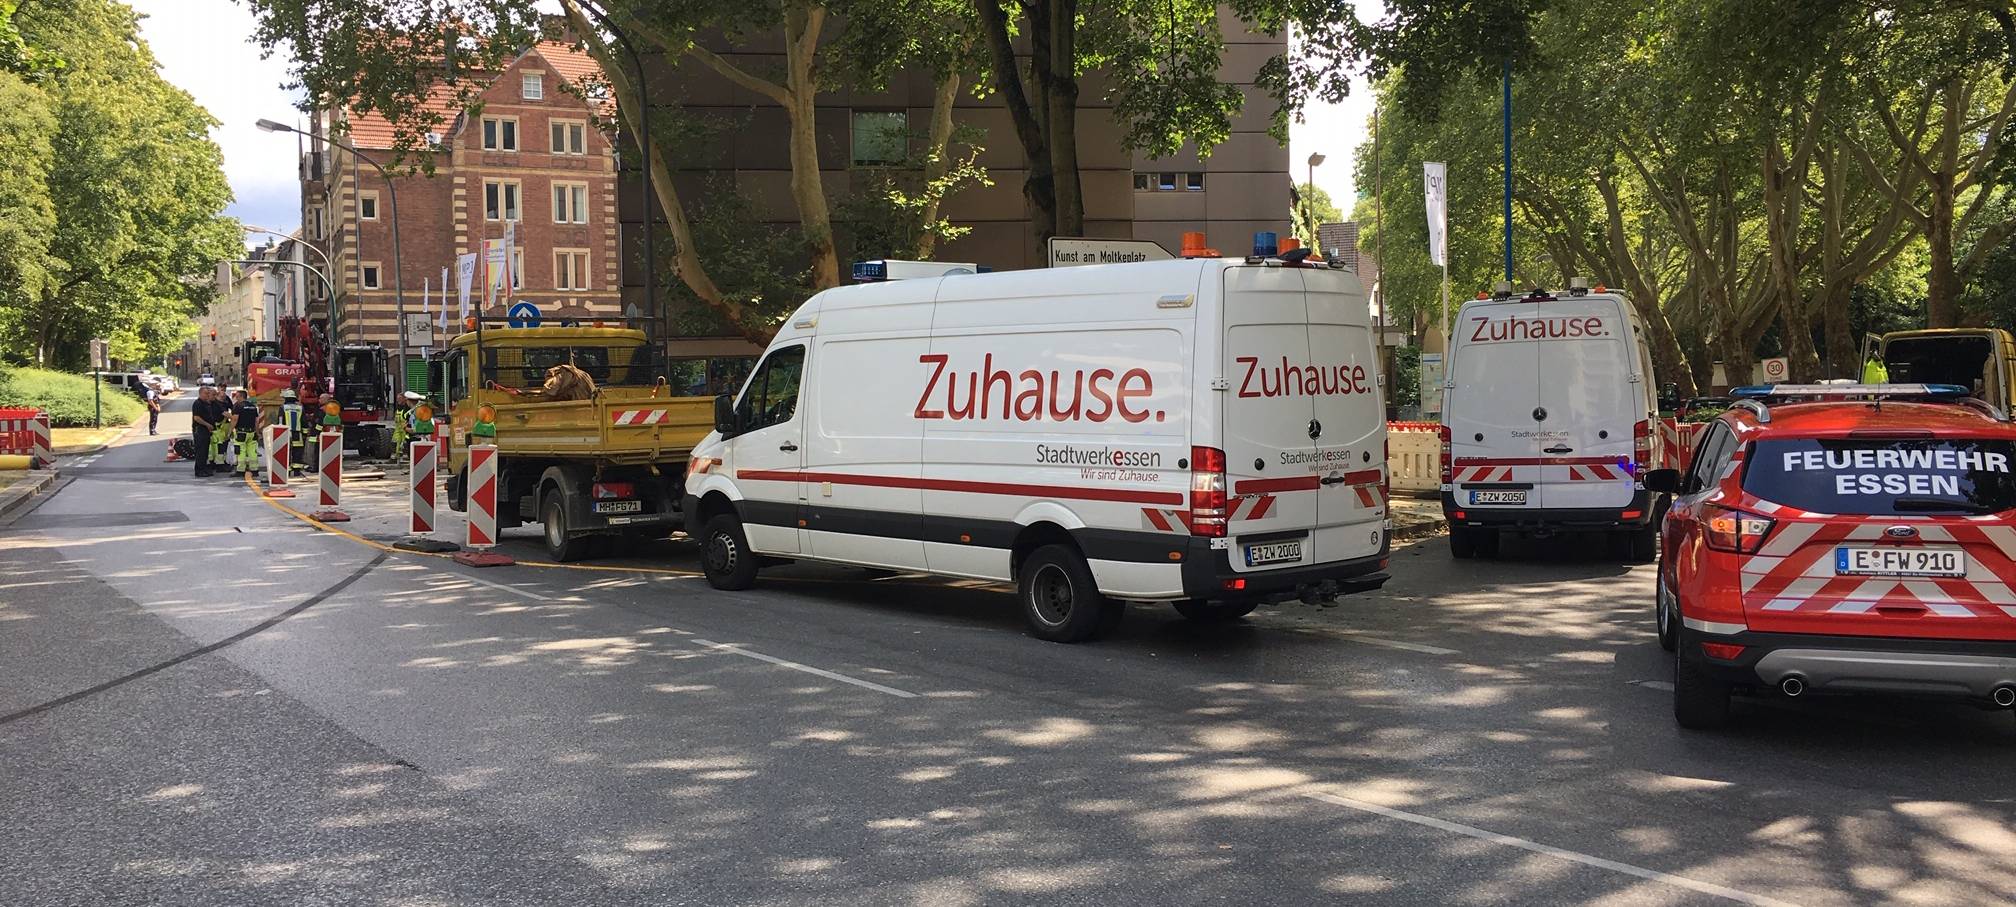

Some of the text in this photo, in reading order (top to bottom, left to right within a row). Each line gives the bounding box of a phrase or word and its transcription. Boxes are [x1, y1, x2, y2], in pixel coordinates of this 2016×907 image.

[1055, 250, 1147, 263] Kunst am Moltkeplatz
[1470, 315, 1610, 342] Zuhause.
[1236, 356, 1371, 398] Zuhause.
[1770, 363, 1780, 372] 30
[912, 352, 1166, 423] Zuhause.
[1036, 444, 1161, 467] Stadtwerkessen
[1280, 449, 1351, 465] Stadtwerkessen
[1783, 449, 2010, 473] FEUERWEHR
[1080, 468, 1096, 480] Wir
[1097, 469, 1117, 480] sind
[1836, 474, 1959, 496] ESSEN
[1501, 492, 1525, 501] 2050
[1277, 543, 1300, 558] 2000
[1856, 551, 1955, 571] E FW 910
